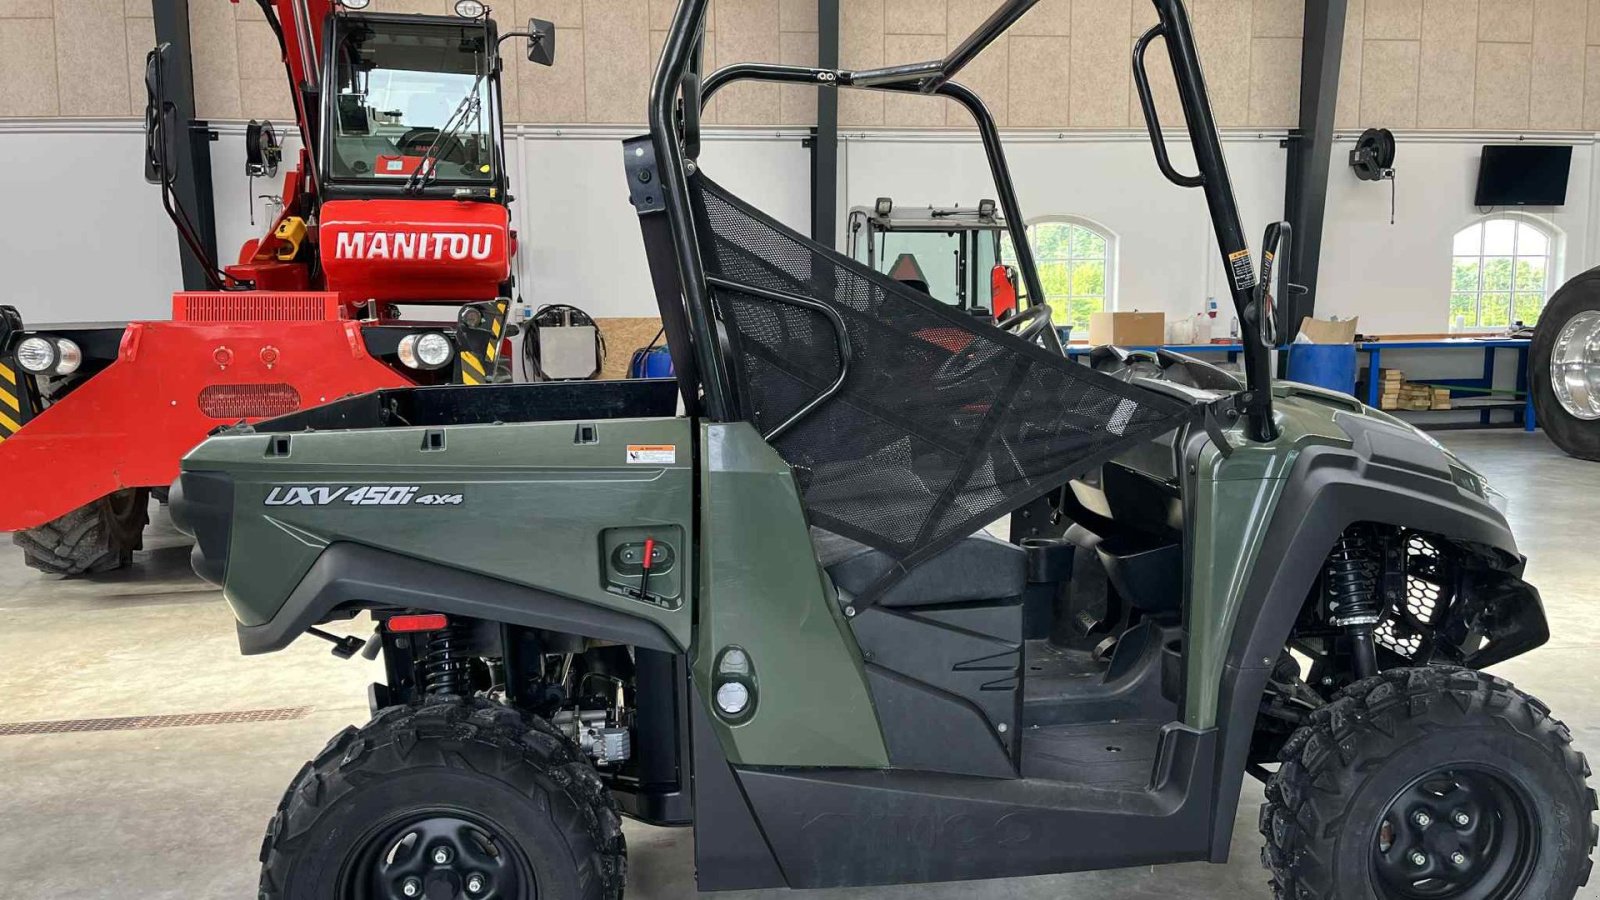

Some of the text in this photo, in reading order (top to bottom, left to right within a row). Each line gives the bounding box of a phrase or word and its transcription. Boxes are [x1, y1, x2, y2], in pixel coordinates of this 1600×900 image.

[335, 231, 493, 260] MANITOU
[264, 486, 349, 505] UXV
[344, 486, 420, 505] 450i
